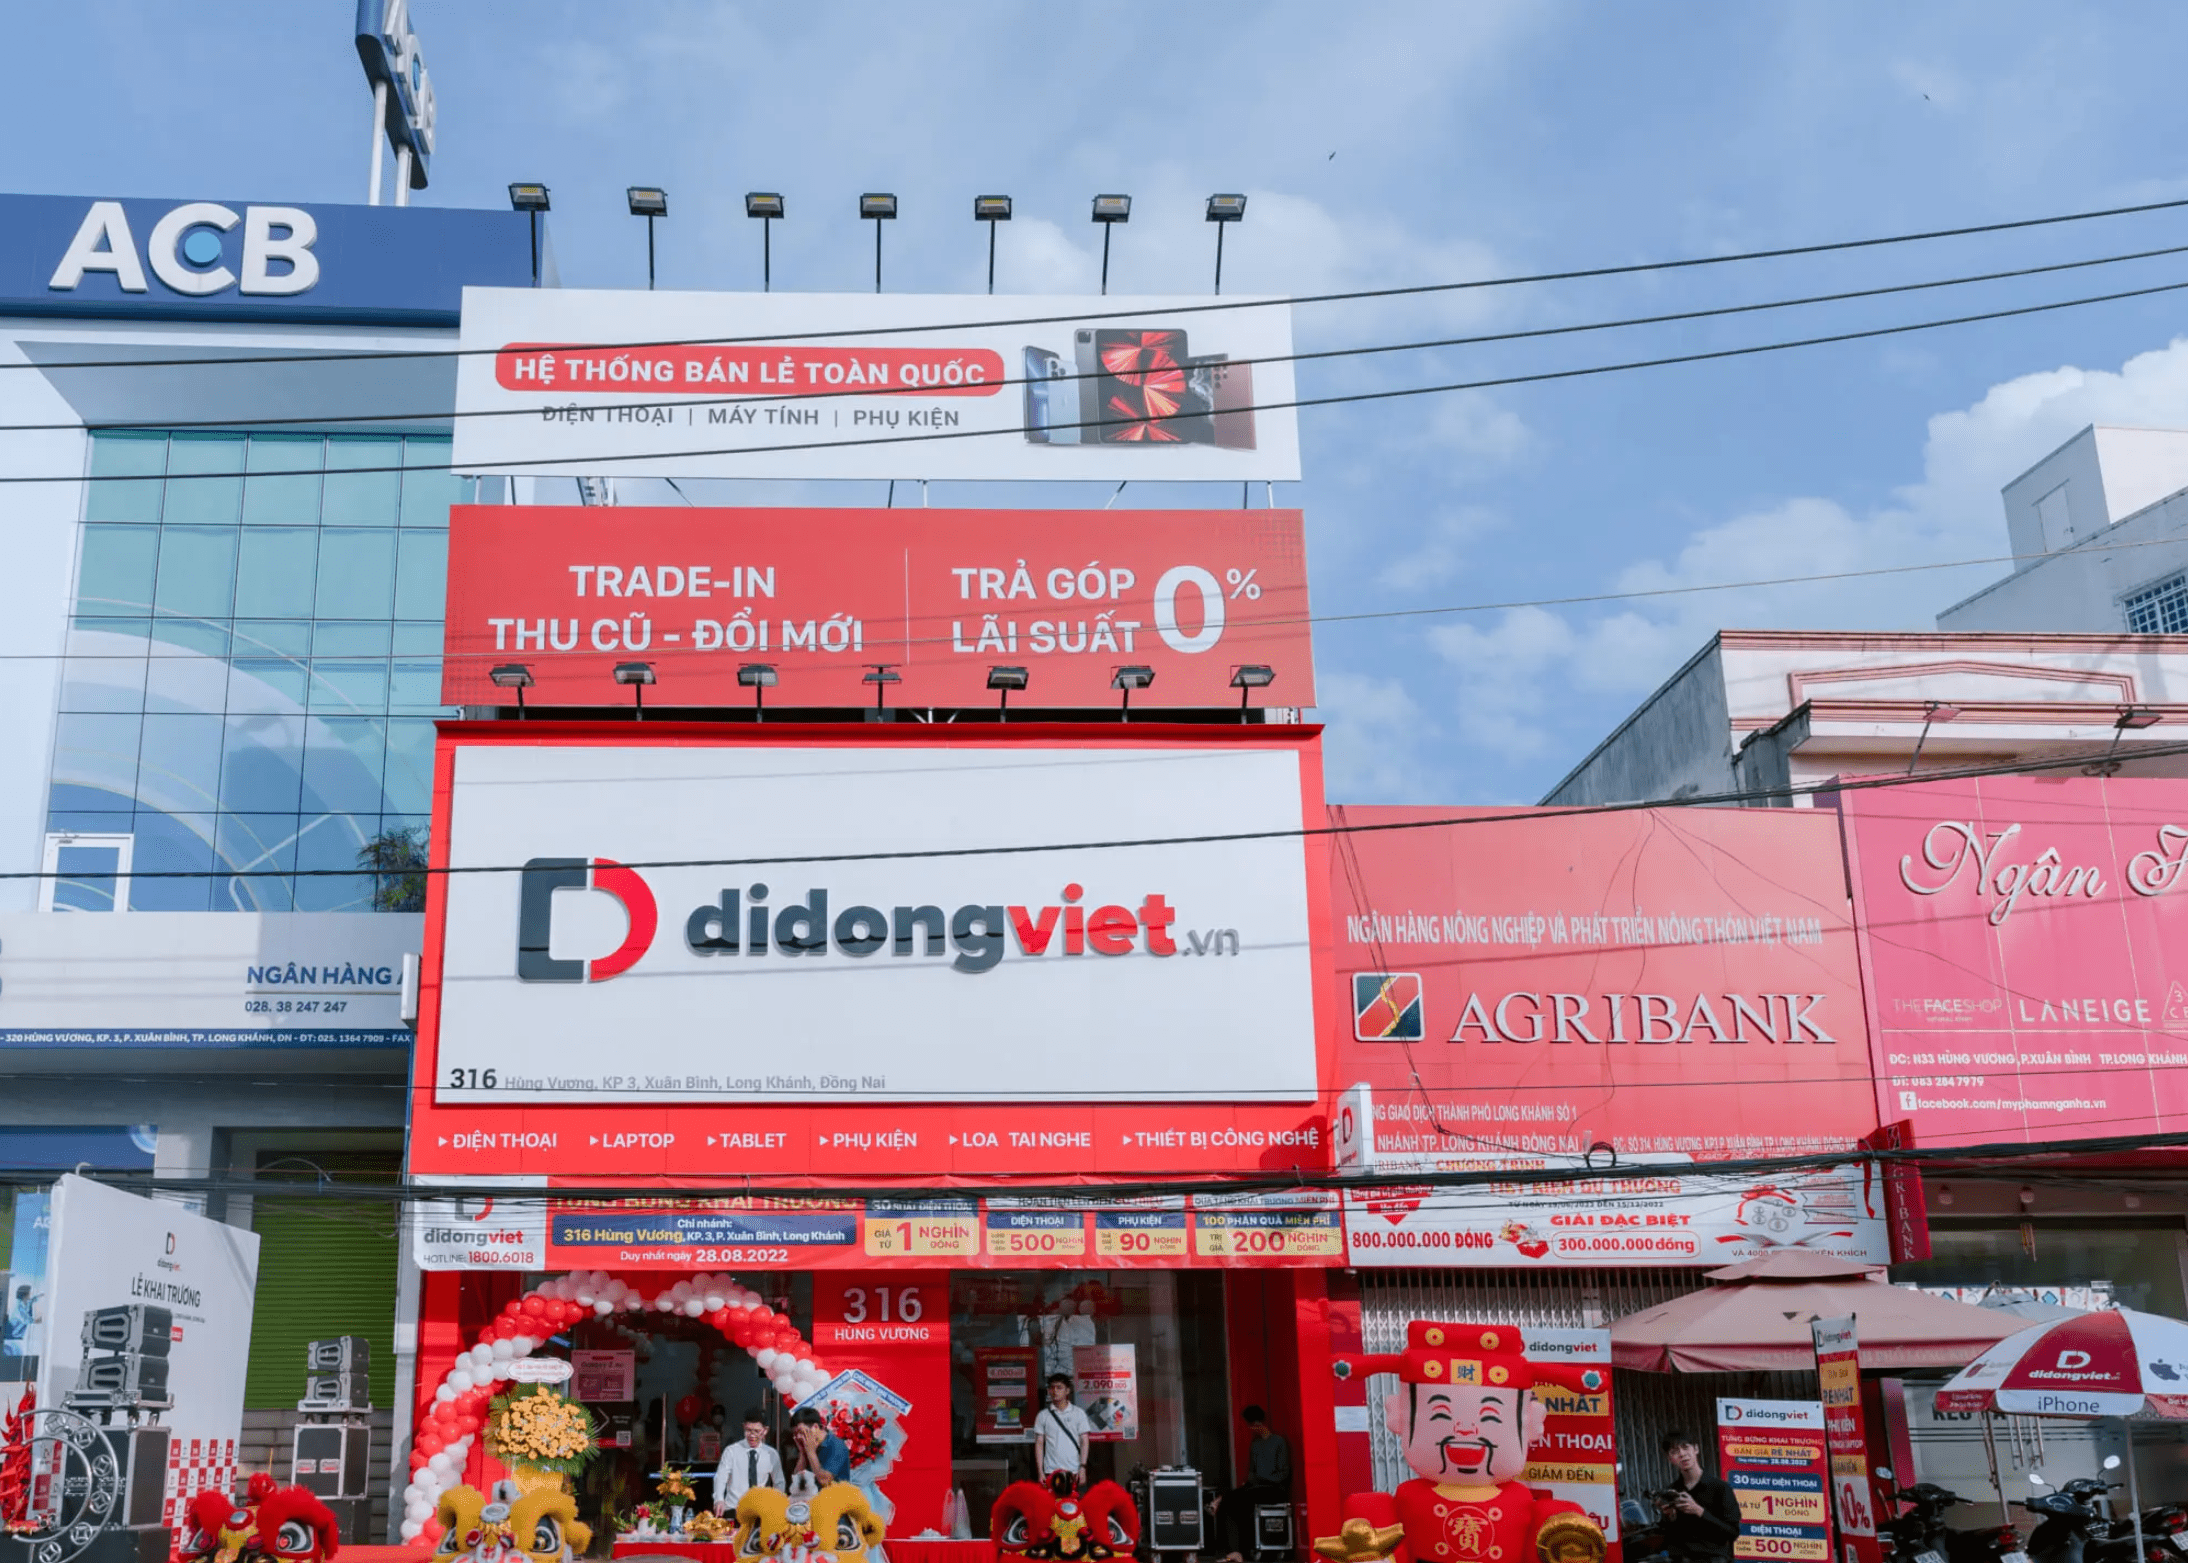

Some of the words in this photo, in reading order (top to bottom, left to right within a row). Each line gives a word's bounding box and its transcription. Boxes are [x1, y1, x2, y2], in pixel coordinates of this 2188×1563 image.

[49, 202, 320, 296] ACB
[515, 353, 556, 385] HỆ
[565, 353, 674, 382] THỐNG
[685, 356, 749, 383] BÁN
[760, 356, 795, 383] LẺ
[804, 358, 888, 385] TOÀN
[899, 358, 985, 387] QUỐC
[542, 403, 594, 426] ĐIỆN
[606, 407, 673, 427] THOẠI
[708, 405, 757, 424] MÁY
[765, 405, 819, 425] TÍNH
[854, 410, 899, 429] PHỤ
[908, 407, 959, 429] KIỆN
[569, 565, 775, 598] TRADE-IN
[952, 559, 1037, 600] TRẢ
[1047, 561, 1135, 600] GÓP
[488, 618, 578, 651] THU
[591, 612, 651, 651] CŨ
[692, 606, 767, 652] ĐỔI
[782, 612, 862, 652] MỚI
[953, 613, 1016, 654] LÃI
[1030, 610, 1141, 654] SUẤT
[1901, 821, 2107, 925] Ngân
[1347, 909, 1393, 943] NGÂN
[1396, 909, 1439, 943] HÀNG
[1443, 909, 1489, 944] NÔNG
[1491, 910, 1545, 950] NGHIỆP
[1549, 909, 1567, 944] VÀ
[1570, 911, 1608, 944] PHÁT
[1612, 906, 1655, 944] TRIỂN
[1658, 910, 1703, 944] NÔNG
[1704, 911, 1749, 944] THÔN
[1751, 911, 1781, 950] VIỆT
[1786, 917, 1823, 944] NAM
[247, 961, 317, 985] NGÂN
[322, 962, 392, 985] HÀNG
[245, 1001, 272, 1013] 028.
[276, 1001, 292, 1013] 38
[296, 1001, 319, 1013] 247
[324, 1001, 347, 1013] 247
[2019, 999, 2152, 1022] LANEIGE
[1449, 992, 1837, 1043] AGRIBANK
[24, 1031, 53, 1043] HÙNG
[134, 1031, 163, 1043] XUÂN
[208, 1034, 237, 1043] LONG
[392, 1034, 411, 1043] FAX
[1937, 1050, 1971, 1065] HÙNG
[2065, 1049, 2091, 1065] BÌNH
[450, 1068, 498, 1090] 316
[505, 1076, 543, 1091] Hùng
[603, 1076, 623, 1089] KP
[627, 1076, 640, 1091] 3,
[645, 1075, 681, 1089] Xuân
[686, 1075, 722, 1090] Bình,
[727, 1076, 761, 1091] Long
[766, 1075, 816, 1090] Khánh,
[820, 1073, 857, 1091] Đồng
[862, 1075, 886, 1089] Nai
[1388, 1104, 1413, 1121] GIAO
[1438, 1101, 1470, 1121] THÀNH
[1493, 1105, 1519, 1121] LONG
[1521, 1101, 1554, 1121] KHÁNH
[453, 1131, 497, 1152] ĐIỆN
[500, 1132, 557, 1152] THOẠI
[602, 1133, 675, 1149] LAPTOP
[720, 1133, 787, 1149] TABLET
[833, 1132, 870, 1150] PHỤ
[875, 1129, 917, 1150] KIỆN
[962, 1132, 998, 1148] LOA
[1009, 1132, 1037, 1148] TAI
[1039, 1131, 1091, 1148] NGHE
[1135, 1127, 1186, 1147] THIẾT
[1189, 1130, 1207, 1150] BỊ
[1210, 1127, 1264, 1147] CÔNG
[1269, 1127, 1318, 1150] NGHỆ
[1377, 1132, 1418, 1151] NHÁNH
[1441, 1135, 1474, 1151] LONG
[1477, 1132, 1519, 1151] KHÁNH
[678, 1218, 695, 1228] Chi
[696, 1218, 733, 1228] nhánh:
[1011, 1215, 1033, 1227] ĐIỆN
[1034, 1216, 1064, 1227] THOẠI
[1118, 1216, 1138, 1228] PHỤ
[1139, 1215, 1162, 1228] KIỆN
[1204, 1217, 1225, 1226] 100
[1261, 1215, 1282, 1226] QUÀ
[1550, 1212, 1594, 1226] GIẢI
[1600, 1212, 1641, 1228] ĐẶC
[1646, 1212, 1691, 1228] BIỆT
[564, 1229, 591, 1242] 316
[595, 1229, 634, 1244] Hùng
[727, 1231, 754, 1241] Xuân
[755, 1231, 782, 1242] Bình,
[783, 1231, 809, 1242] Long
[811, 1230, 845, 1241] Khánh
[896, 1221, 912, 1251] 1
[919, 1225, 970, 1239] NGHÌN
[1010, 1234, 1056, 1251] 500
[1120, 1232, 1151, 1251] 90
[1233, 1231, 1285, 1252] 200
[1288, 1231, 1328, 1244] NGHÌN
[1352, 1231, 1450, 1249] 800.000.000
[1455, 1227, 1493, 1249] ĐỒNG
[1558, 1237, 1653, 1251] 300.000.000
[1655, 1236, 1694, 1253] đồng
[468, 1251, 534, 1264] 1800.6018
[620, 1251, 640, 1263] Duy
[643, 1250, 665, 1260] nhất
[667, 1250, 692, 1262] ngày
[696, 1248, 788, 1263] 28.08.2022
[131, 1272, 143, 1296] LỄ
[143, 1279, 165, 1300] KHAI
[844, 1287, 922, 1323] 316
[835, 1325, 875, 1340] HÙNG
[879, 1327, 929, 1340] VƯƠNG
[1529, 1341, 1598, 1354] didongviet
[1545, 1394, 1601, 1413] NHẤT
[2037, 1395, 2100, 1413] iPhone
[1746, 1409, 1809, 1421] didongviet
[1555, 1433, 1612, 1453] THOẠI
[1528, 1466, 1563, 1480] GIẢM
[1566, 1465, 1594, 1481] ĐẾN
[1733, 1475, 1749, 1485] 30
[1762, 1495, 1774, 1515] 1
[1775, 1496, 1818, 1508] NGHÌN
[1750, 1524, 1772, 1536] ĐIỆN
[1773, 1526, 1802, 1537] THOẠI
[1755, 1539, 1793, 1554] 500
